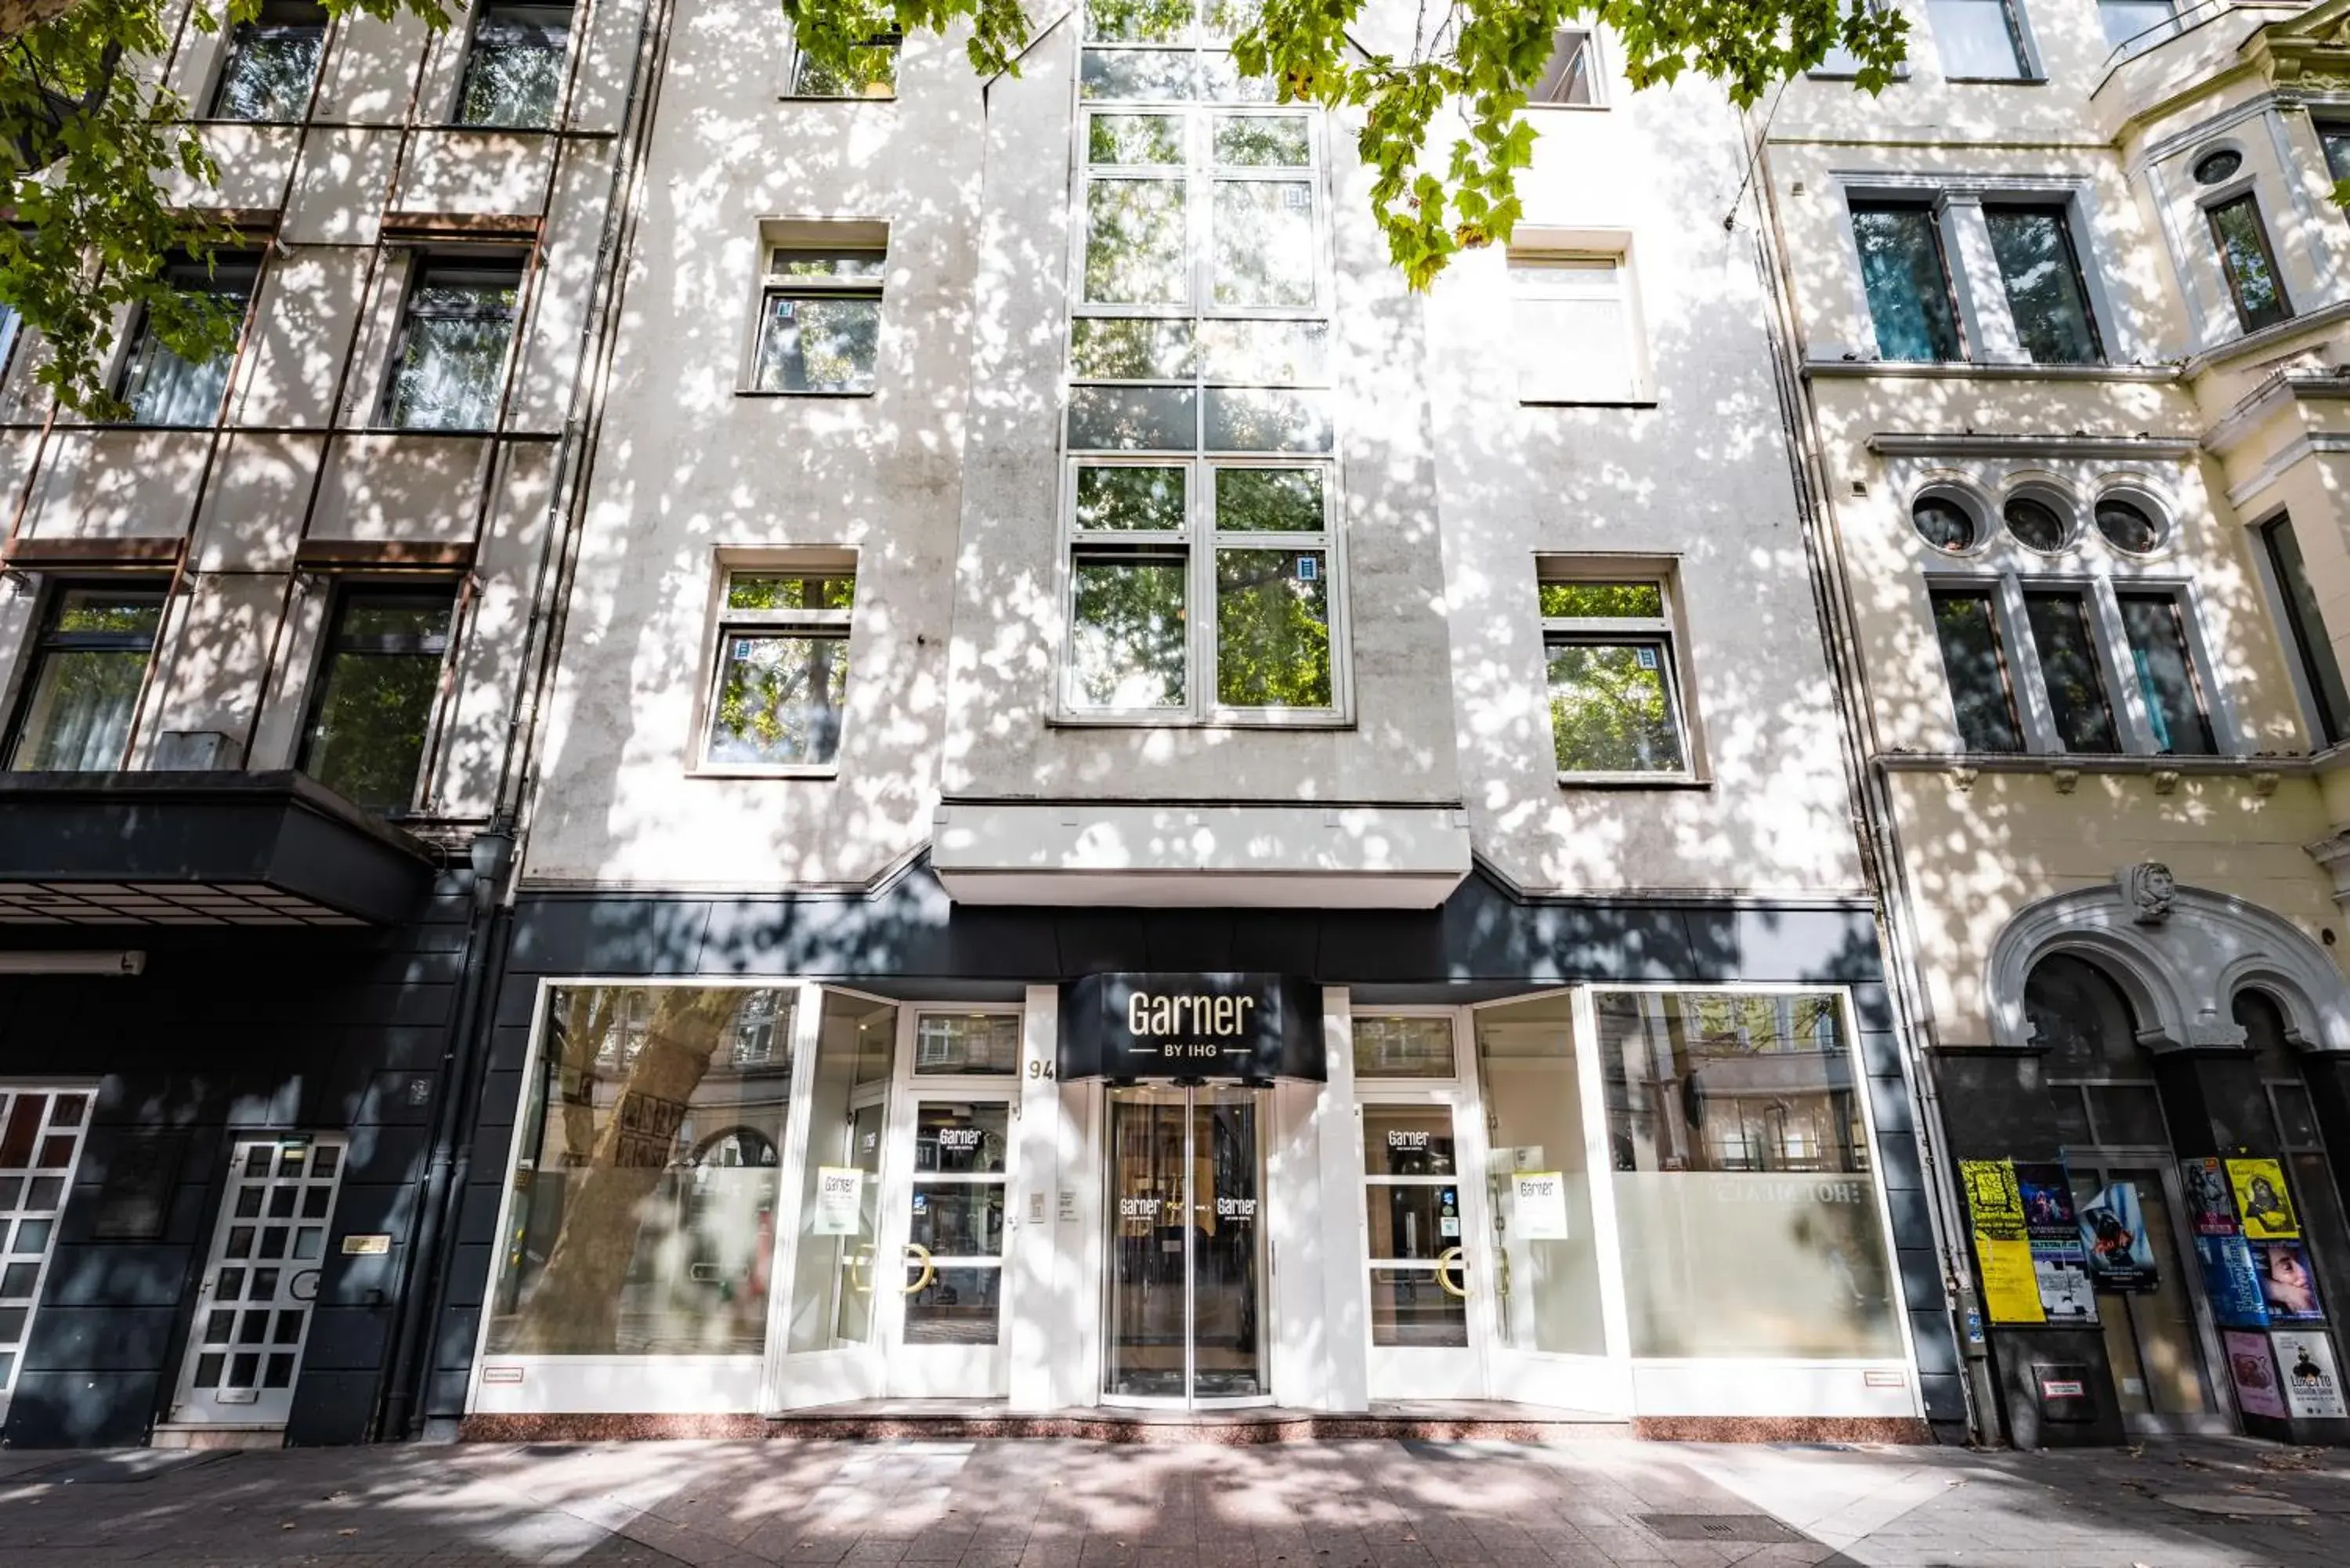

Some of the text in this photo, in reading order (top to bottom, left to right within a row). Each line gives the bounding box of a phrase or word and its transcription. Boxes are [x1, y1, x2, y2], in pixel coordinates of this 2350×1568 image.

[1129, 992, 1253, 1035] Garner
[1164, 1044, 1217, 1057] BY IHG
[1029, 1060, 1055, 1079] 94
[939, 1128, 982, 1144] Garner
[1388, 1130, 1430, 1146] Garner
[1520, 1182, 1553, 1197] Garner
[1120, 1198, 1160, 1215] Garner
[1217, 1198, 1256, 1215] Garner
